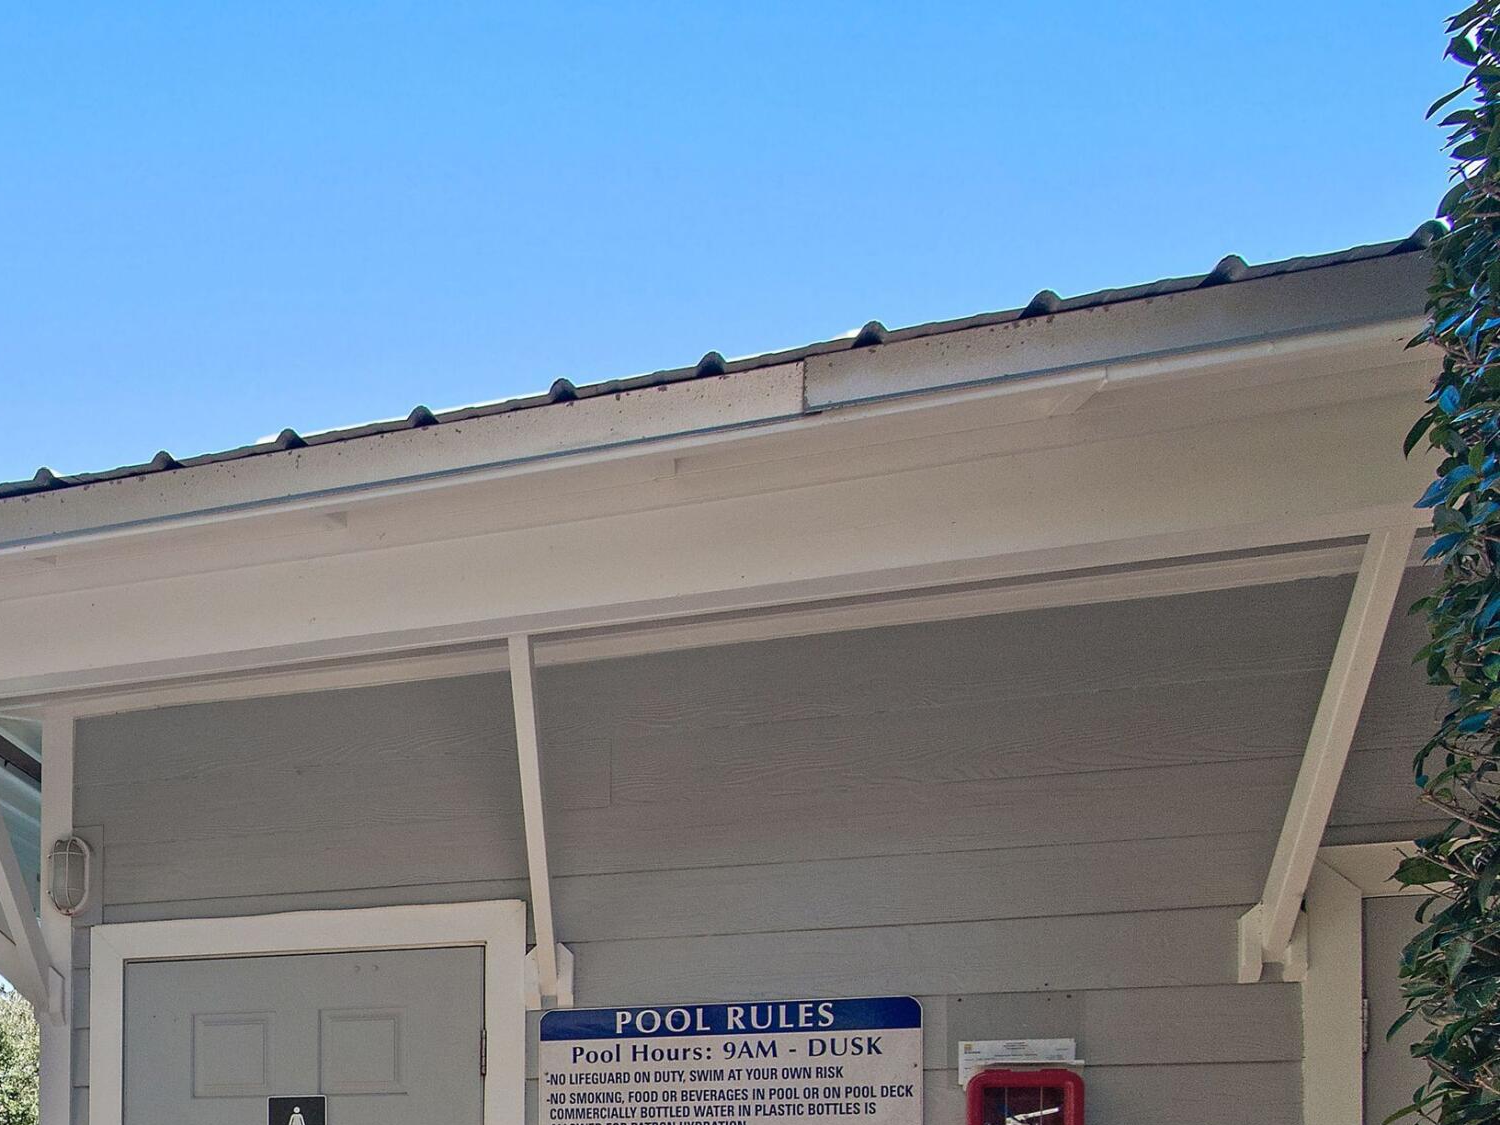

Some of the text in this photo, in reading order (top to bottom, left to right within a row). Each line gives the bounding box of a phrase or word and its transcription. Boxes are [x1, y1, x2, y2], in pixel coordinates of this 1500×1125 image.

[616, 1002, 834, 1033] POOL RULES
[572, 1043, 620, 1064] Pool
[632, 1044, 711, 1062] Hours:
[723, 1039, 778, 1060] 9AM
[808, 1036, 883, 1057] DUSK
[569, 1071, 631, 1085] LIFEGUARD
[634, 1071, 650, 1084] ON
[654, 1070, 686, 1083] DUTY,
[689, 1069, 724, 1082] SWIM
[727, 1068, 743, 1081] AT
[745, 1067, 778, 1080] YOUR
[781, 1066, 812, 1080] OWN
[815, 1065, 844, 1079] RISK
[569, 1091, 624, 1104] SMOKING,
[628, 1090, 658, 1103] FOOD
[661, 1090, 677, 1102] OR
[680, 1088, 748, 1102] BEVERAGES
[752, 1088, 765, 1100] IN
[768, 1087, 800, 1100] POOL
[802, 1087, 819, 1100] OR
[822, 1086, 840, 1099] ON
[844, 1085, 877, 1098] POOL
[880, 1084, 913, 1098] DECK
[549, 1101, 876, 1120] COMMERCIALLY BOTTLED WATER IN PLASTIC BOTTLES IS
